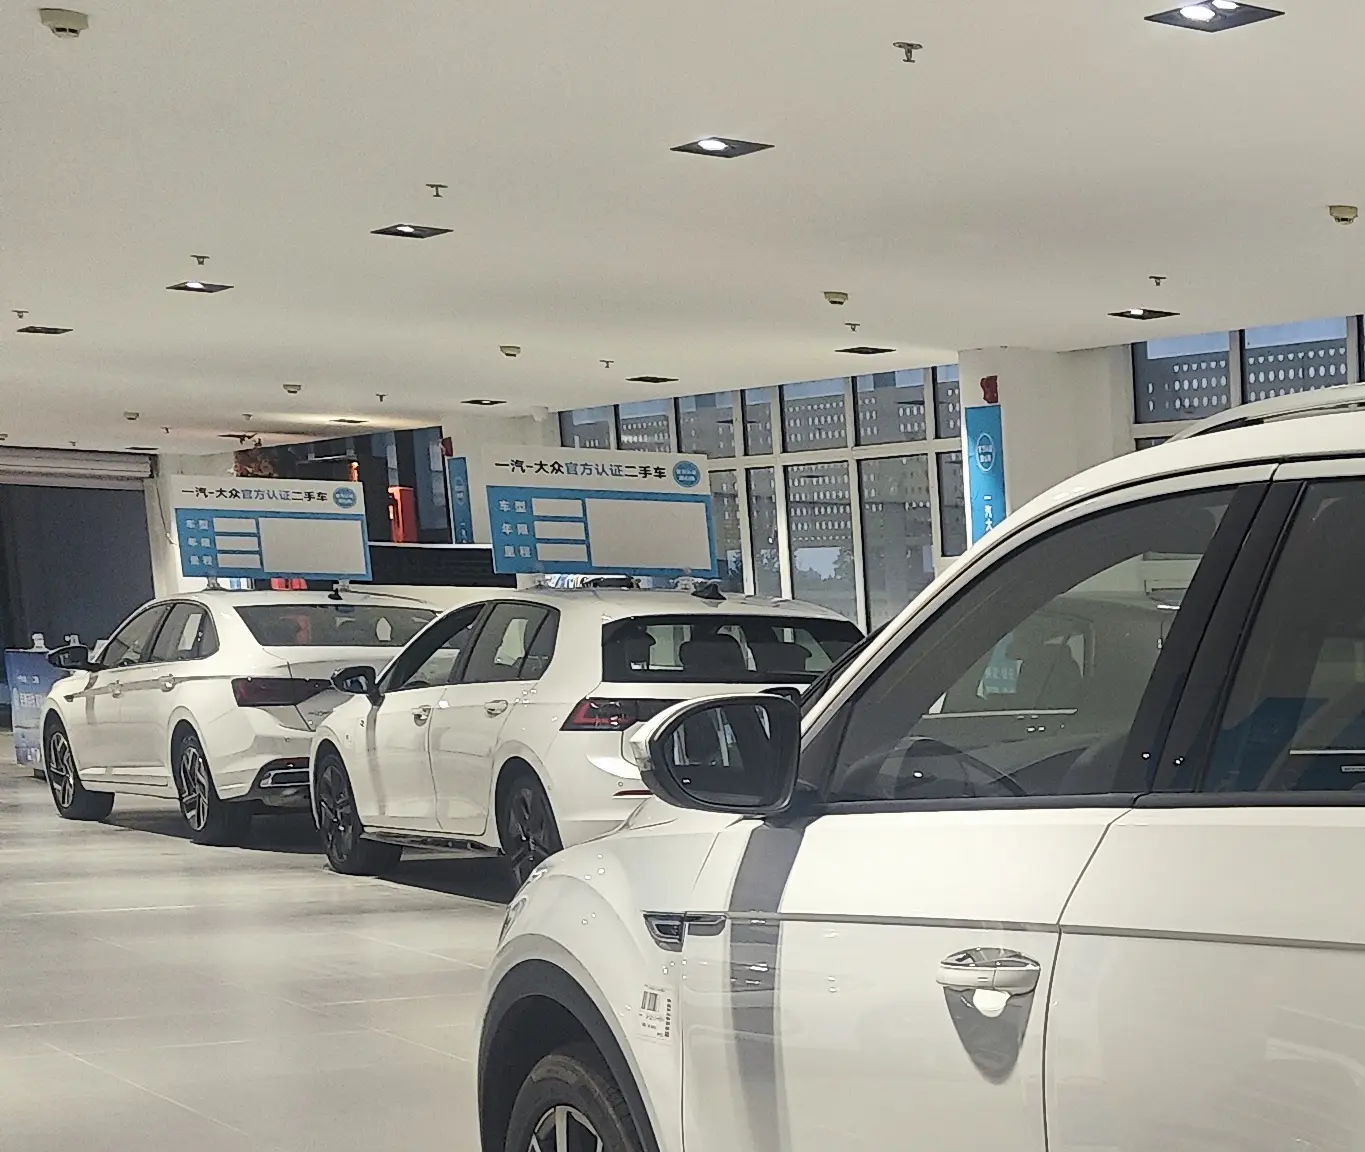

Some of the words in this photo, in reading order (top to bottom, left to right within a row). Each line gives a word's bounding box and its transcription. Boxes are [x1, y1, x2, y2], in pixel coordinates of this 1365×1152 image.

[495, 459, 667, 479] 一汽-大众官方认证二手车
[182, 486, 328, 502] 一汽-大众官方认证二手车
